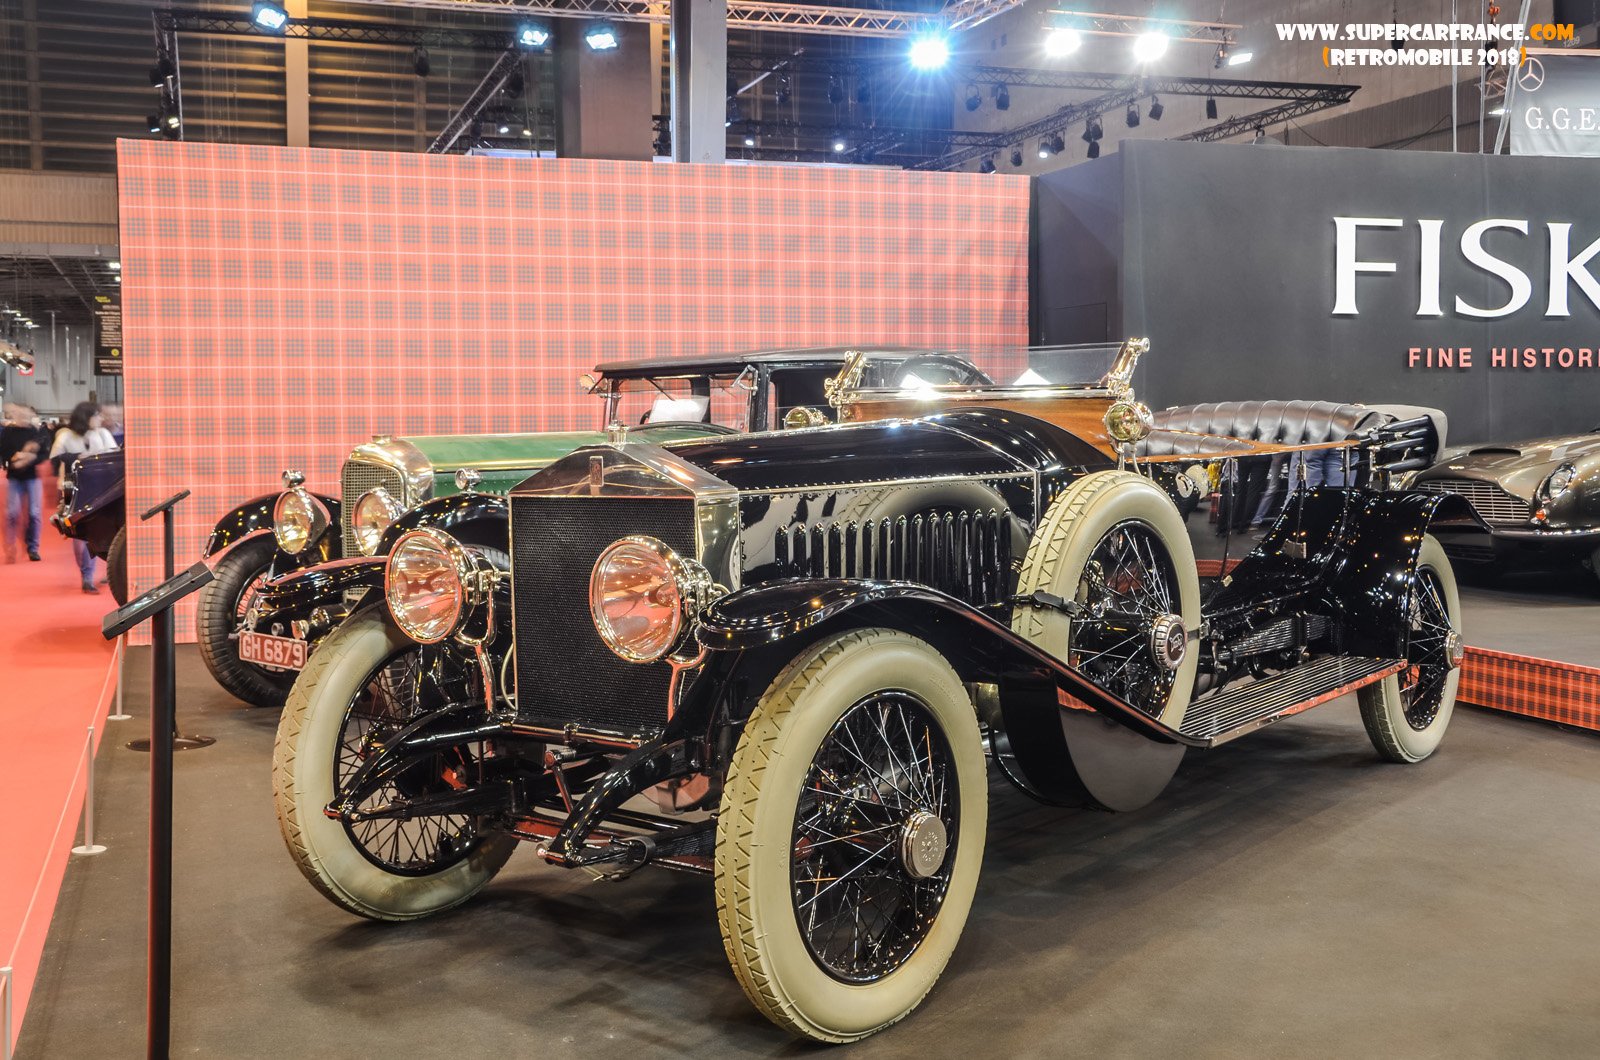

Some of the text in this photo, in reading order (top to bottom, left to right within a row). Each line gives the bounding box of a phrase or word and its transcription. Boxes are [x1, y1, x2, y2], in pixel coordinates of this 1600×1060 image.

[1331, 216, 1600, 318] FISK
[1408, 347, 1473, 368] FINE
[242, 635, 303, 667] GH 6879
